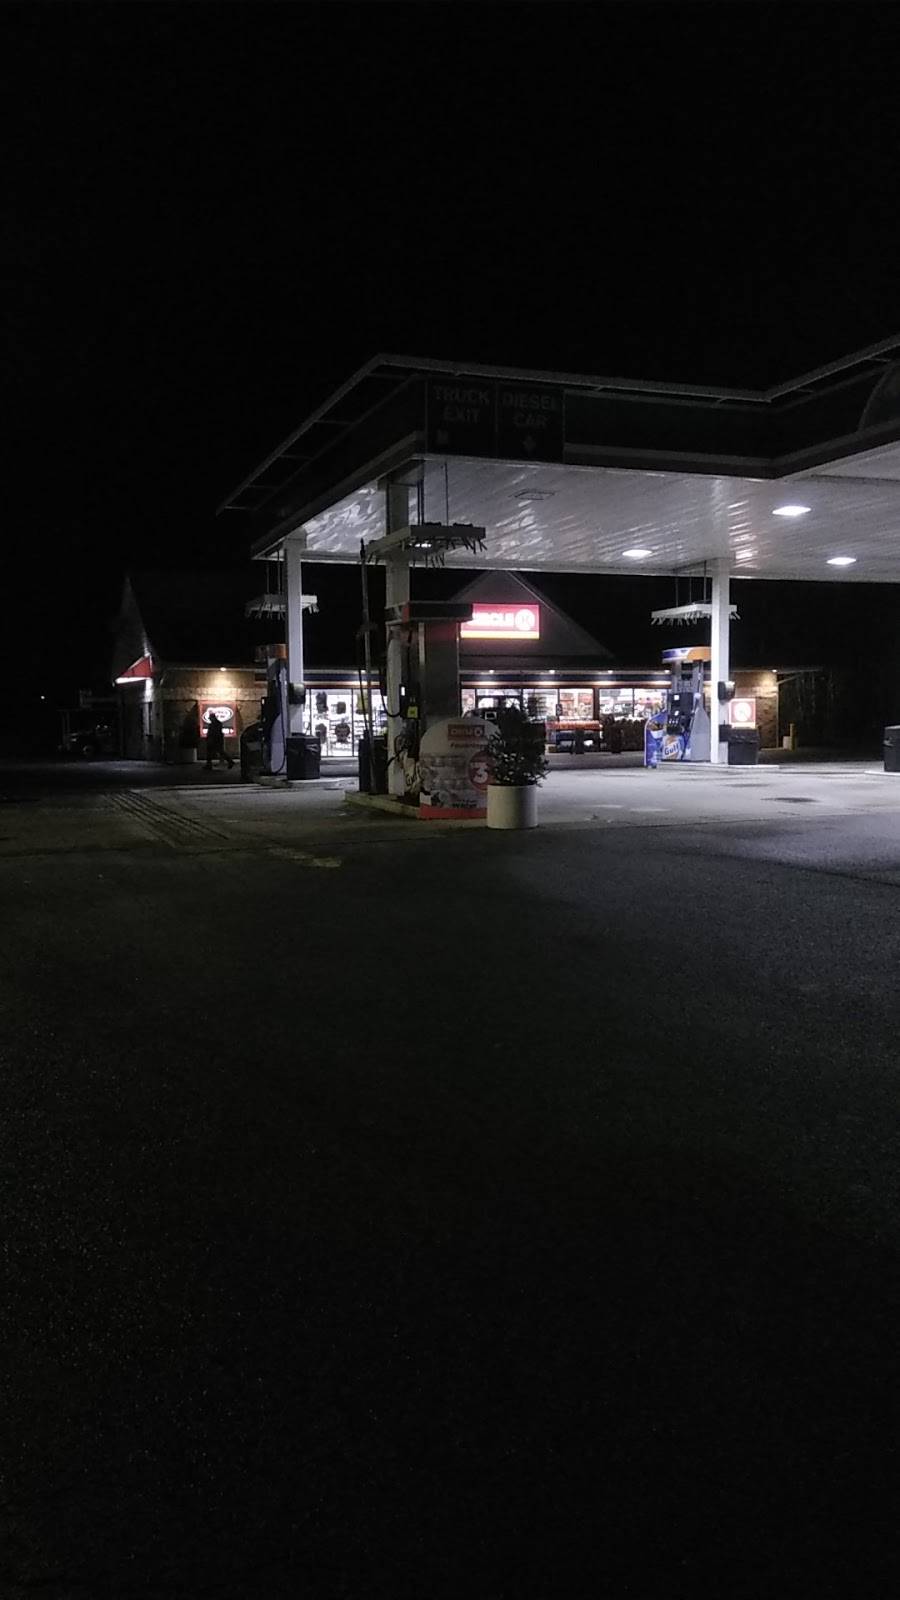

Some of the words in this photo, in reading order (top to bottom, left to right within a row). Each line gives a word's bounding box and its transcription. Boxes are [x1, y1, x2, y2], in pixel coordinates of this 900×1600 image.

[433, 386, 489, 405] TRUCK
[502, 391, 557, 411] DIESEL
[443, 405, 480, 424] EXIT
